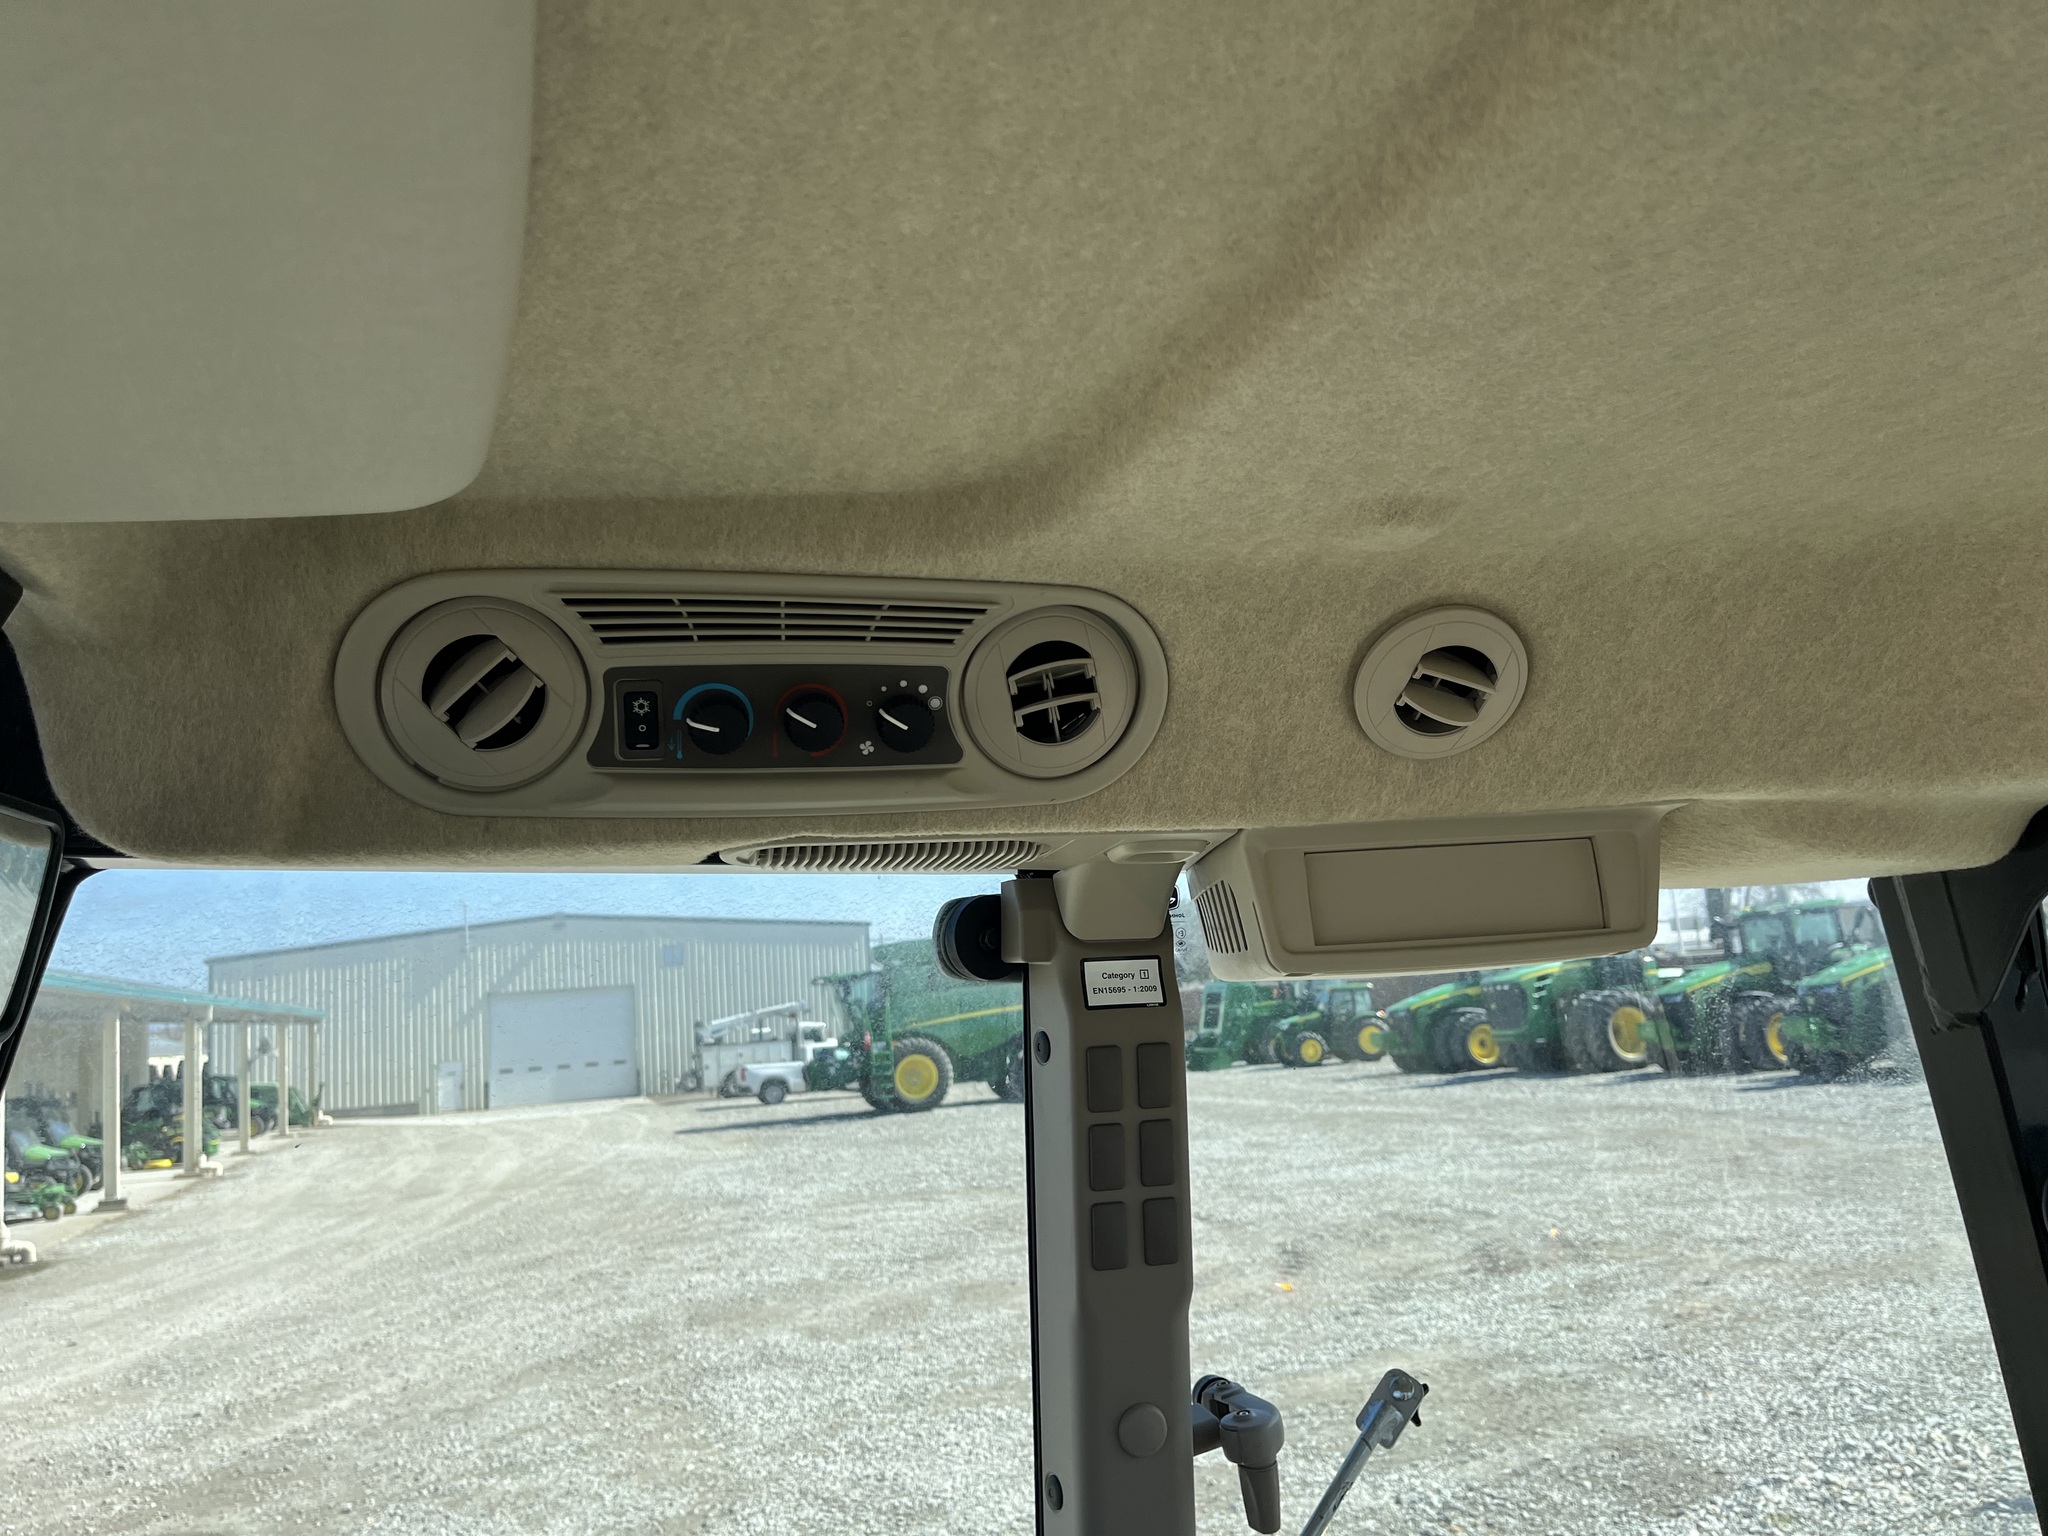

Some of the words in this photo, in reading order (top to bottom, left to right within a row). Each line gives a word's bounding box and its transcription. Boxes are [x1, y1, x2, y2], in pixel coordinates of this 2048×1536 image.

[1101, 972, 1135, 980] Category
[1092, 986, 1127, 995] EN15695
[1133, 985, 1158, 993] 1:2009
